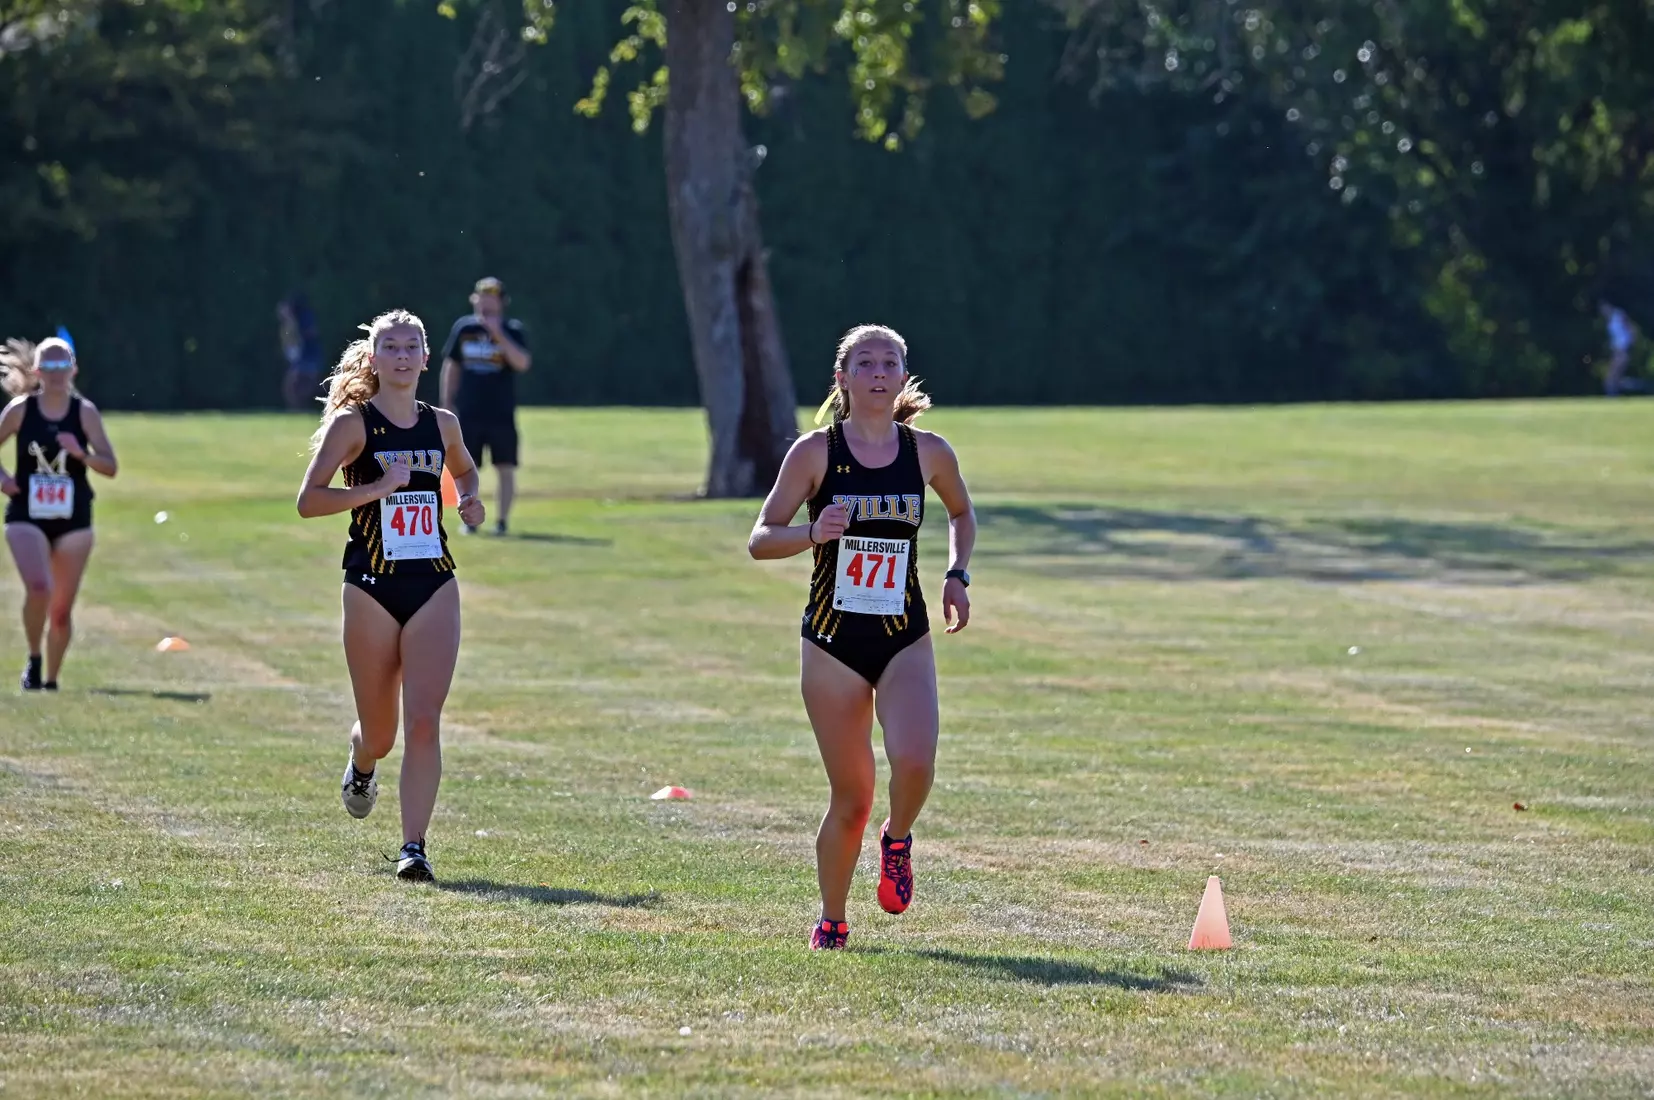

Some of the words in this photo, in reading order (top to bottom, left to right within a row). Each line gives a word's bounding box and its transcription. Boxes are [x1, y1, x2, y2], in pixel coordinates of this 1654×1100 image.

[385, 493, 435, 506] MILLERSVILLE
[390, 505, 433, 537] 470
[844, 539, 906, 554] MILLERSVILLE
[846, 553, 897, 589] 471
